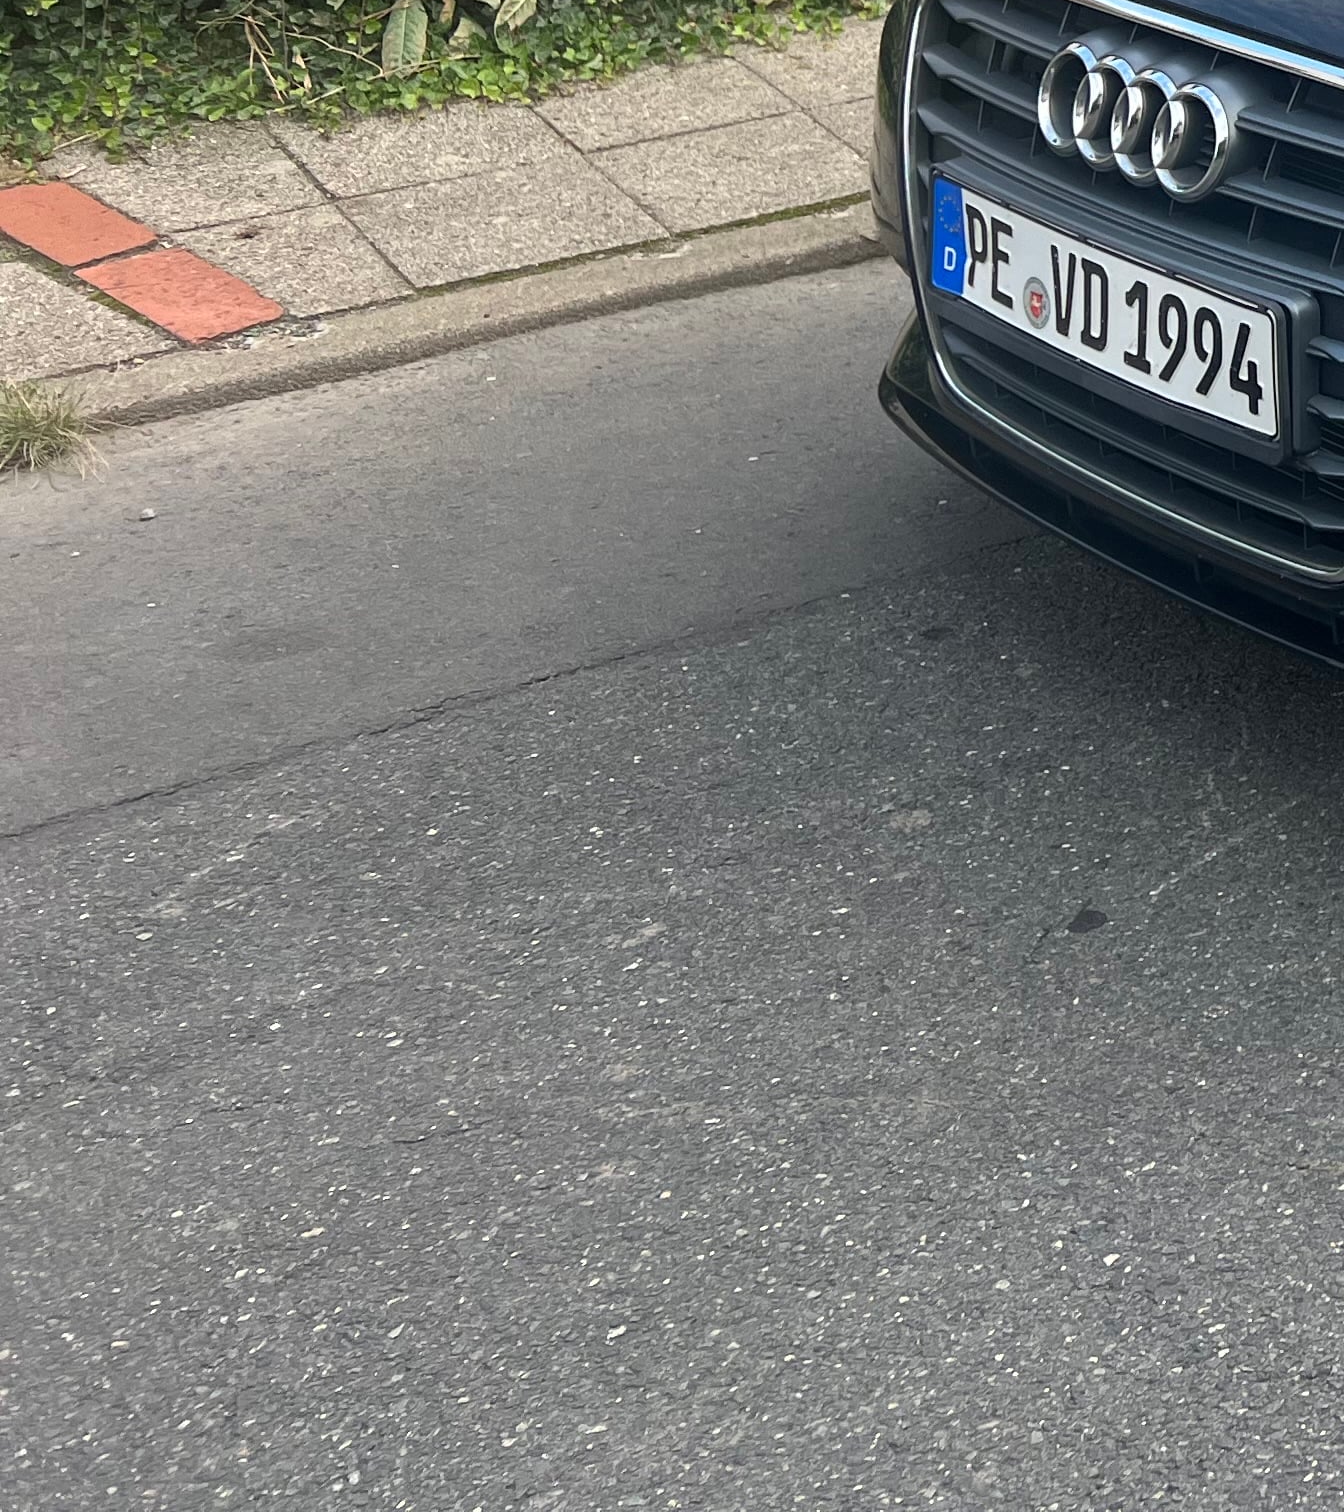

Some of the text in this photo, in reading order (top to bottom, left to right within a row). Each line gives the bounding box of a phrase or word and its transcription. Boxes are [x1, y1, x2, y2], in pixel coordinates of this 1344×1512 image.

[943, 245, 957, 272] D
[965, 203, 1264, 416] PE VD 1994
